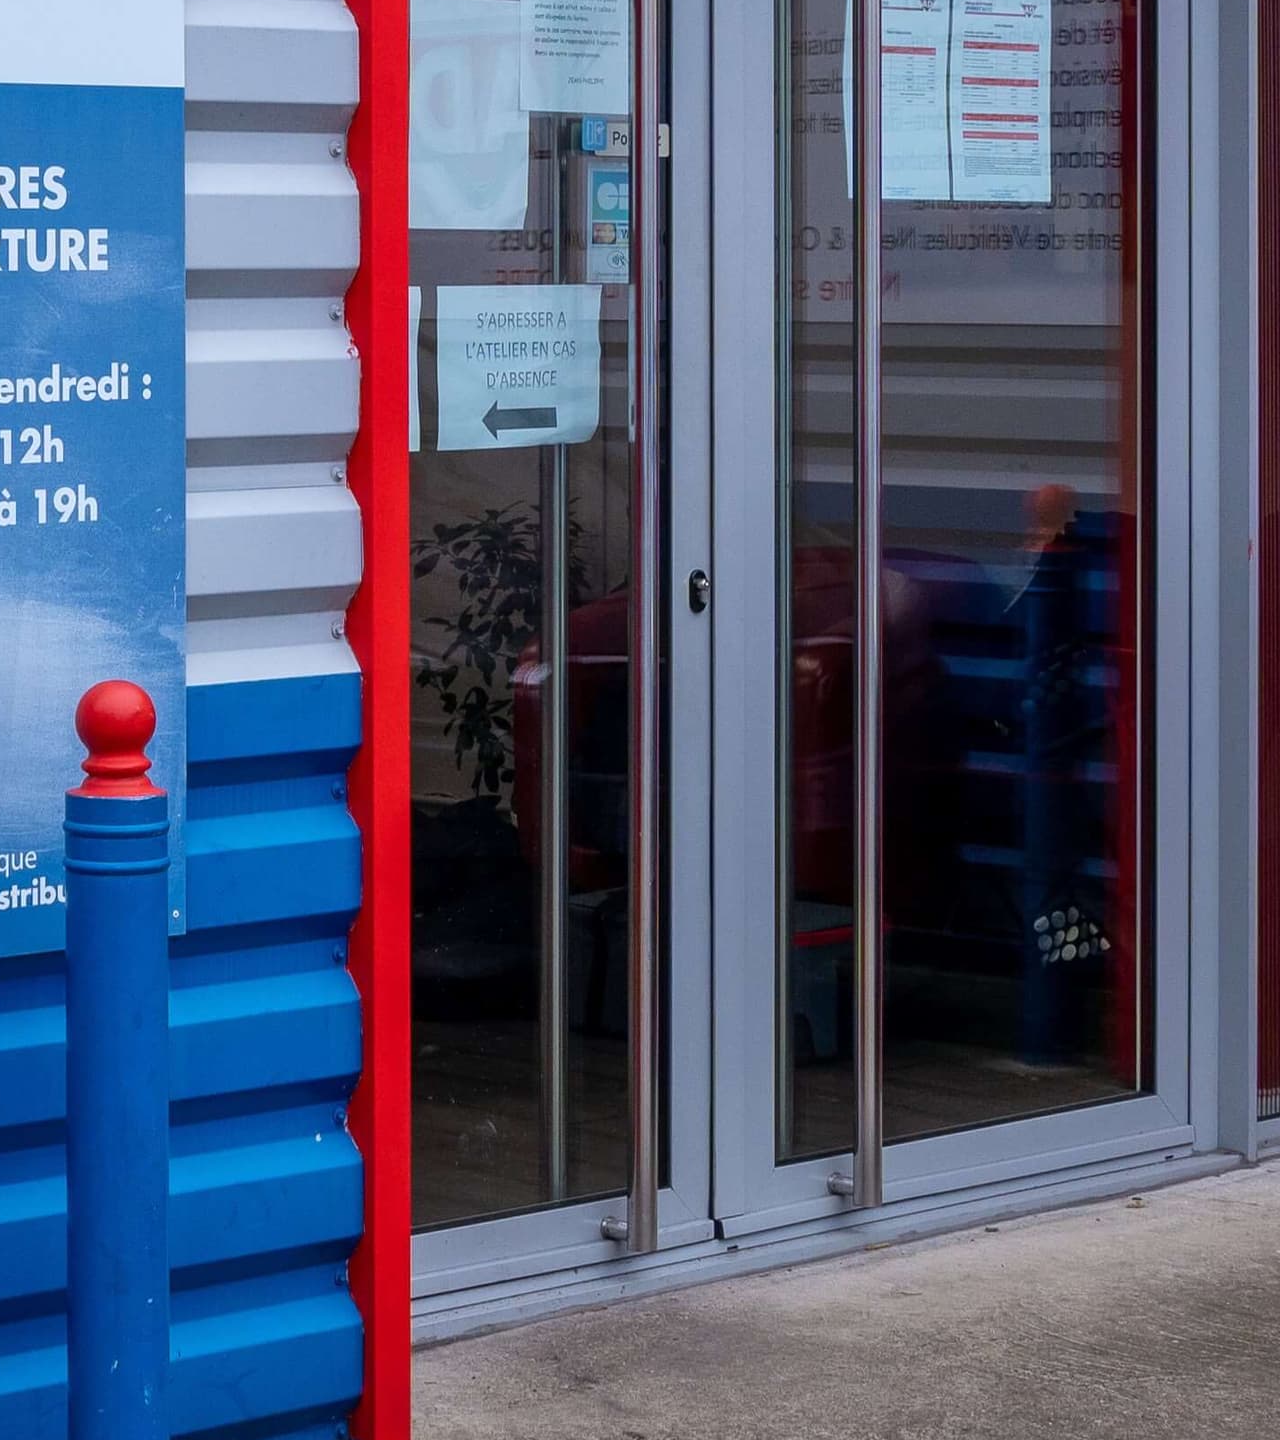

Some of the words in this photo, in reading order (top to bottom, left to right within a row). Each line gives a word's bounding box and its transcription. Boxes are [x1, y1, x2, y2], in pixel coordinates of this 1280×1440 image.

[476, 311, 554, 329] S'ADRESSER
[465, 341, 528, 360] L'ATELIER
[532, 341, 549, 358] EN
[553, 340, 576, 357] CAS
[143, 375, 151, 399] :
[486, 370, 558, 388] D'ABSENCE
[0, 425, 63, 464] 12h
[35, 485, 97, 523] 19h
